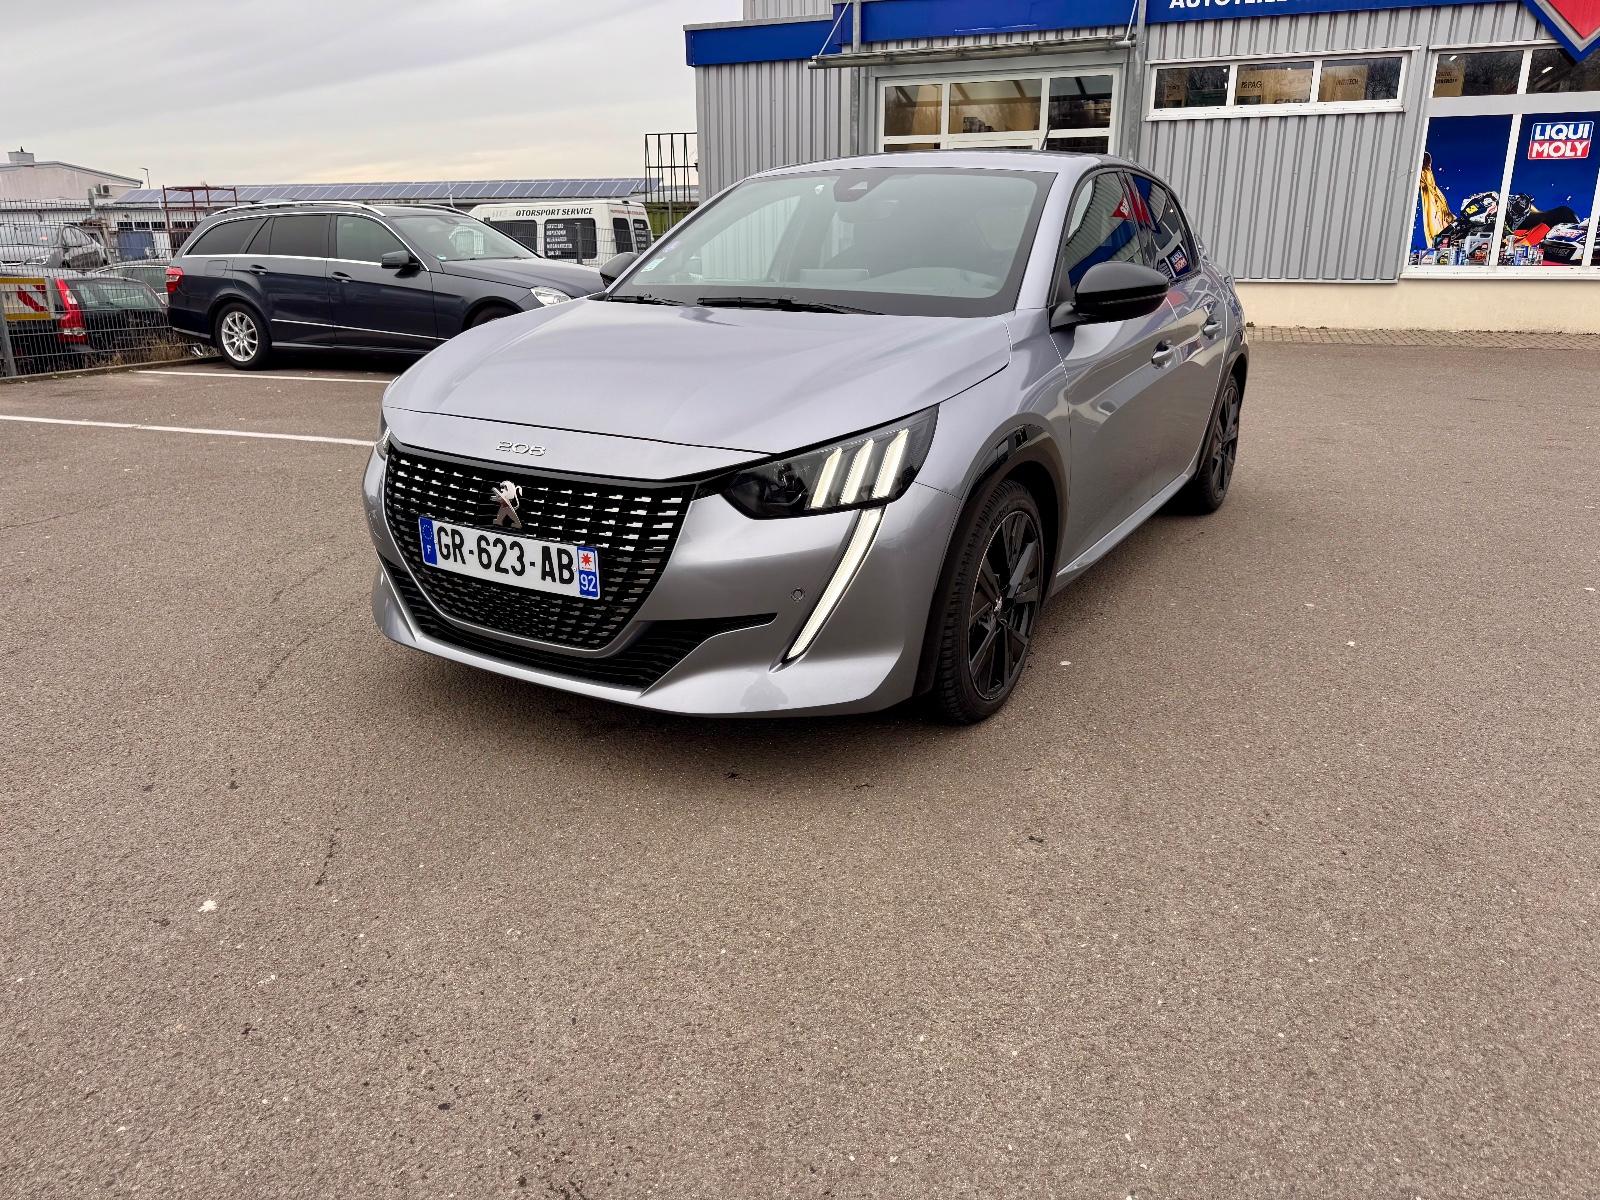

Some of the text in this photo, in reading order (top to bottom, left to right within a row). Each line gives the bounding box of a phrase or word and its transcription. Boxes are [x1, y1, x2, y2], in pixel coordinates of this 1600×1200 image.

[1534, 123, 1590, 140] LIQUI
[1531, 141, 1589, 158] MOLY
[562, 207, 594, 216] SERVICE
[496, 441, 547, 457] 208
[426, 545, 432, 555] F
[437, 526, 575, 585] GR-623-AB
[580, 573, 597, 592] 92
